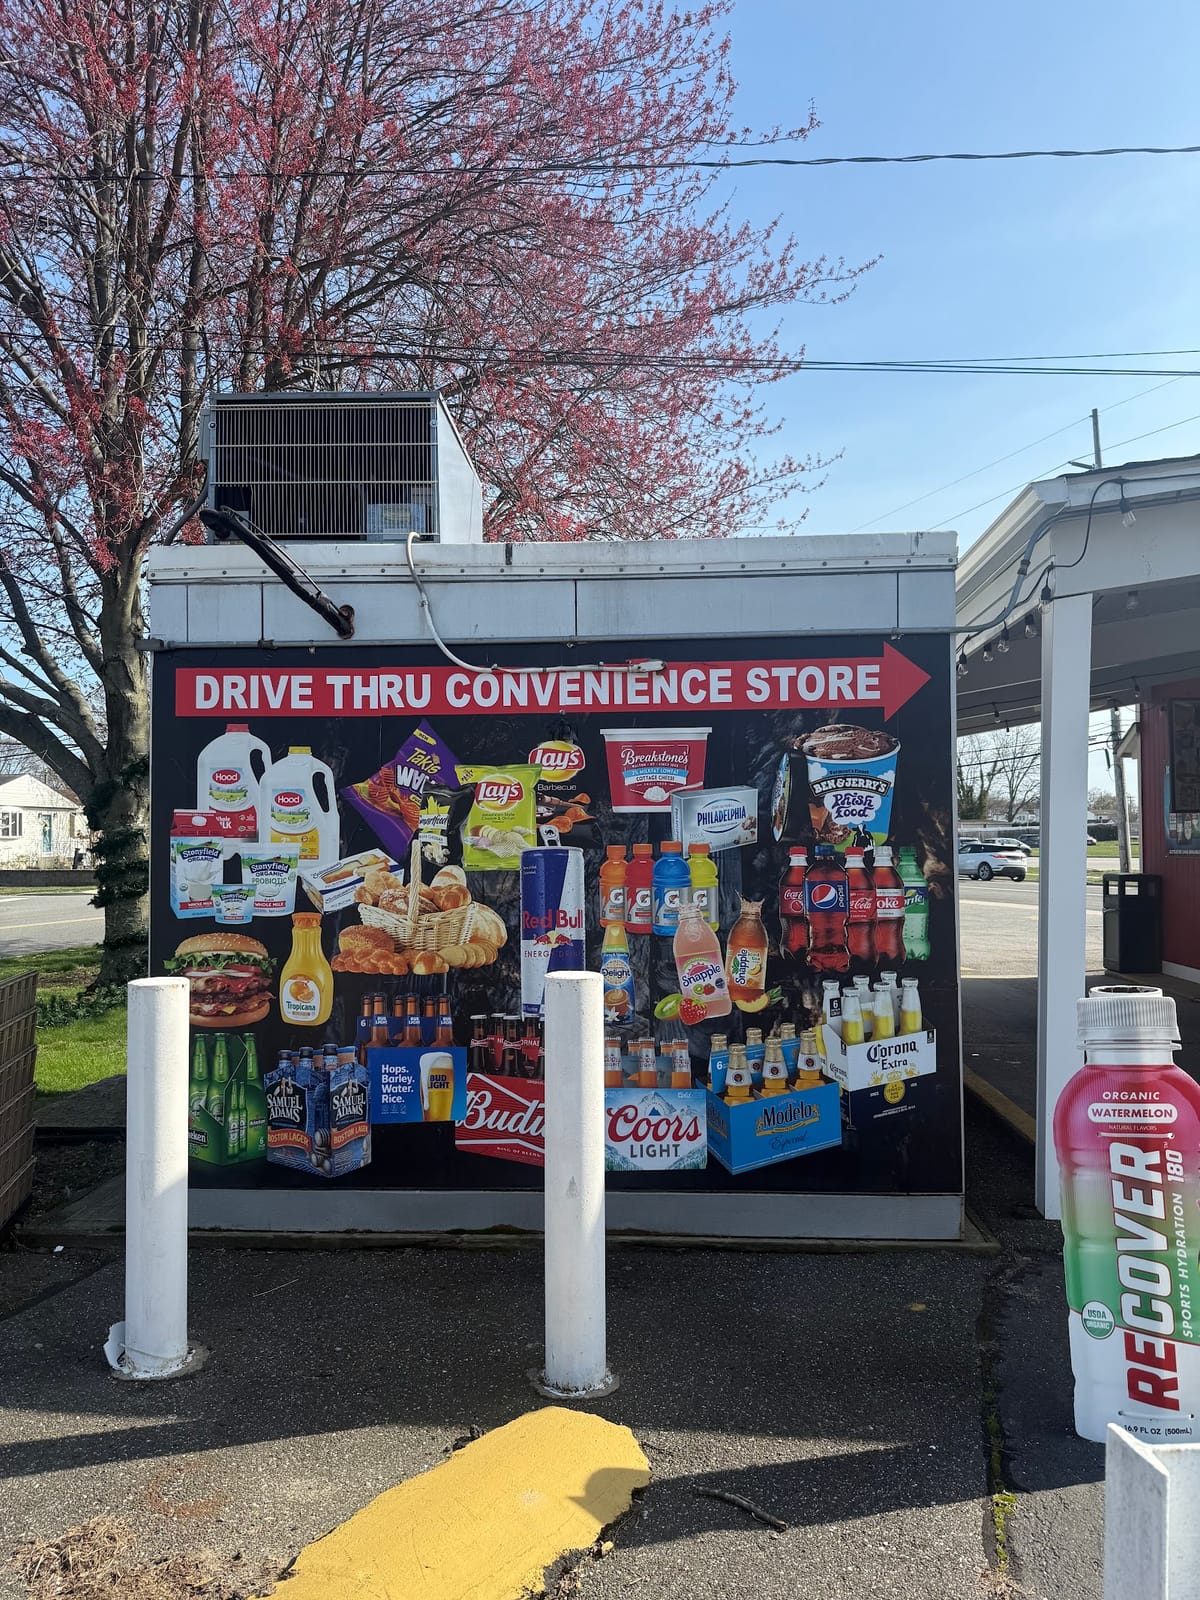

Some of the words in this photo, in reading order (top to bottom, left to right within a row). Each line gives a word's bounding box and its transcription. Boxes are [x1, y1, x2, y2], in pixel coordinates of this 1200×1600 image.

[195, 675, 314, 710] DRIVE
[326, 673, 431, 709] THRU
[445, 669, 733, 708] CONVENIENCE
[745, 665, 881, 702] STORE
[407, 748, 441, 774] Takis
[535, 749, 580, 770] Lay's
[621, 748, 689, 766] Breakstone's
[215, 773, 238, 782] Hood
[277, 795, 300, 804] Hood
[478, 782, 521, 805] Lay's
[832, 793, 874, 809] Phish
[697, 806, 746, 826] PHILADELPHIA
[182, 847, 220, 858] Stonyfield
[251, 862, 289, 873] Stonyfield
[252, 877, 287, 885] PROBIOTIC
[610, 889, 623, 904] G
[636, 890, 651, 907] G
[664, 890, 680, 908] G
[837, 884, 845, 907] pepsi
[876, 897, 899, 909] oke
[522, 909, 551, 929] Red
[556, 909, 583, 929] Bull
[602, 968, 631, 978] Delight
[735, 949, 749, 985] Snapple
[682, 964, 721, 987] Snapple
[286, 1000, 315, 1011] Tropicana
[833, 999, 839, 1009] 6
[866, 1040, 918, 1063] Corona
[381, 1064, 409, 1075] Hops.
[716, 1061, 723, 1070] 6
[881, 1058, 908, 1071] Extra
[381, 1074, 415, 1085] Barley.
[429, 1074, 447, 1082] BUD
[381, 1084, 414, 1093] Water.
[1102, 1091, 1161, 1100] ORGANIC
[266, 1093, 303, 1110] SAMUEL
[332, 1092, 366, 1110] SAMUEL
[381, 1094, 405, 1103] Rice.
[269, 1105, 300, 1123] ADAMS
[335, 1104, 364, 1121] ADAMS
[763, 1101, 813, 1129] Modelo
[1091, 1108, 1173, 1118] WATERMELON
[606, 1104, 702, 1142] Coors
[268, 1133, 288, 1143] BOSTON
[289, 1133, 309, 1145] LAGER
[334, 1131, 353, 1145] BOSTON
[353, 1125, 368, 1136] LAGER
[630, 1143, 680, 1158] LIGHT
[1165, 1149, 1184, 1183] 180
[1172, 1193, 1189, 1278] HYDRATION
[1109, 1142, 1180, 1412] RECOVER
[1087, 1309, 1107, 1320] USDA
[1178, 1283, 1193, 1338] SPORTS
[1086, 1320, 1110, 1330] ORGANIC
[1124, 1424, 1138, 1433] 16.9
[1140, 1426, 1149, 1434] FL
[1150, 1427, 1161, 1435] OZ
[1165, 1427, 1192, 1437] (500mL)
